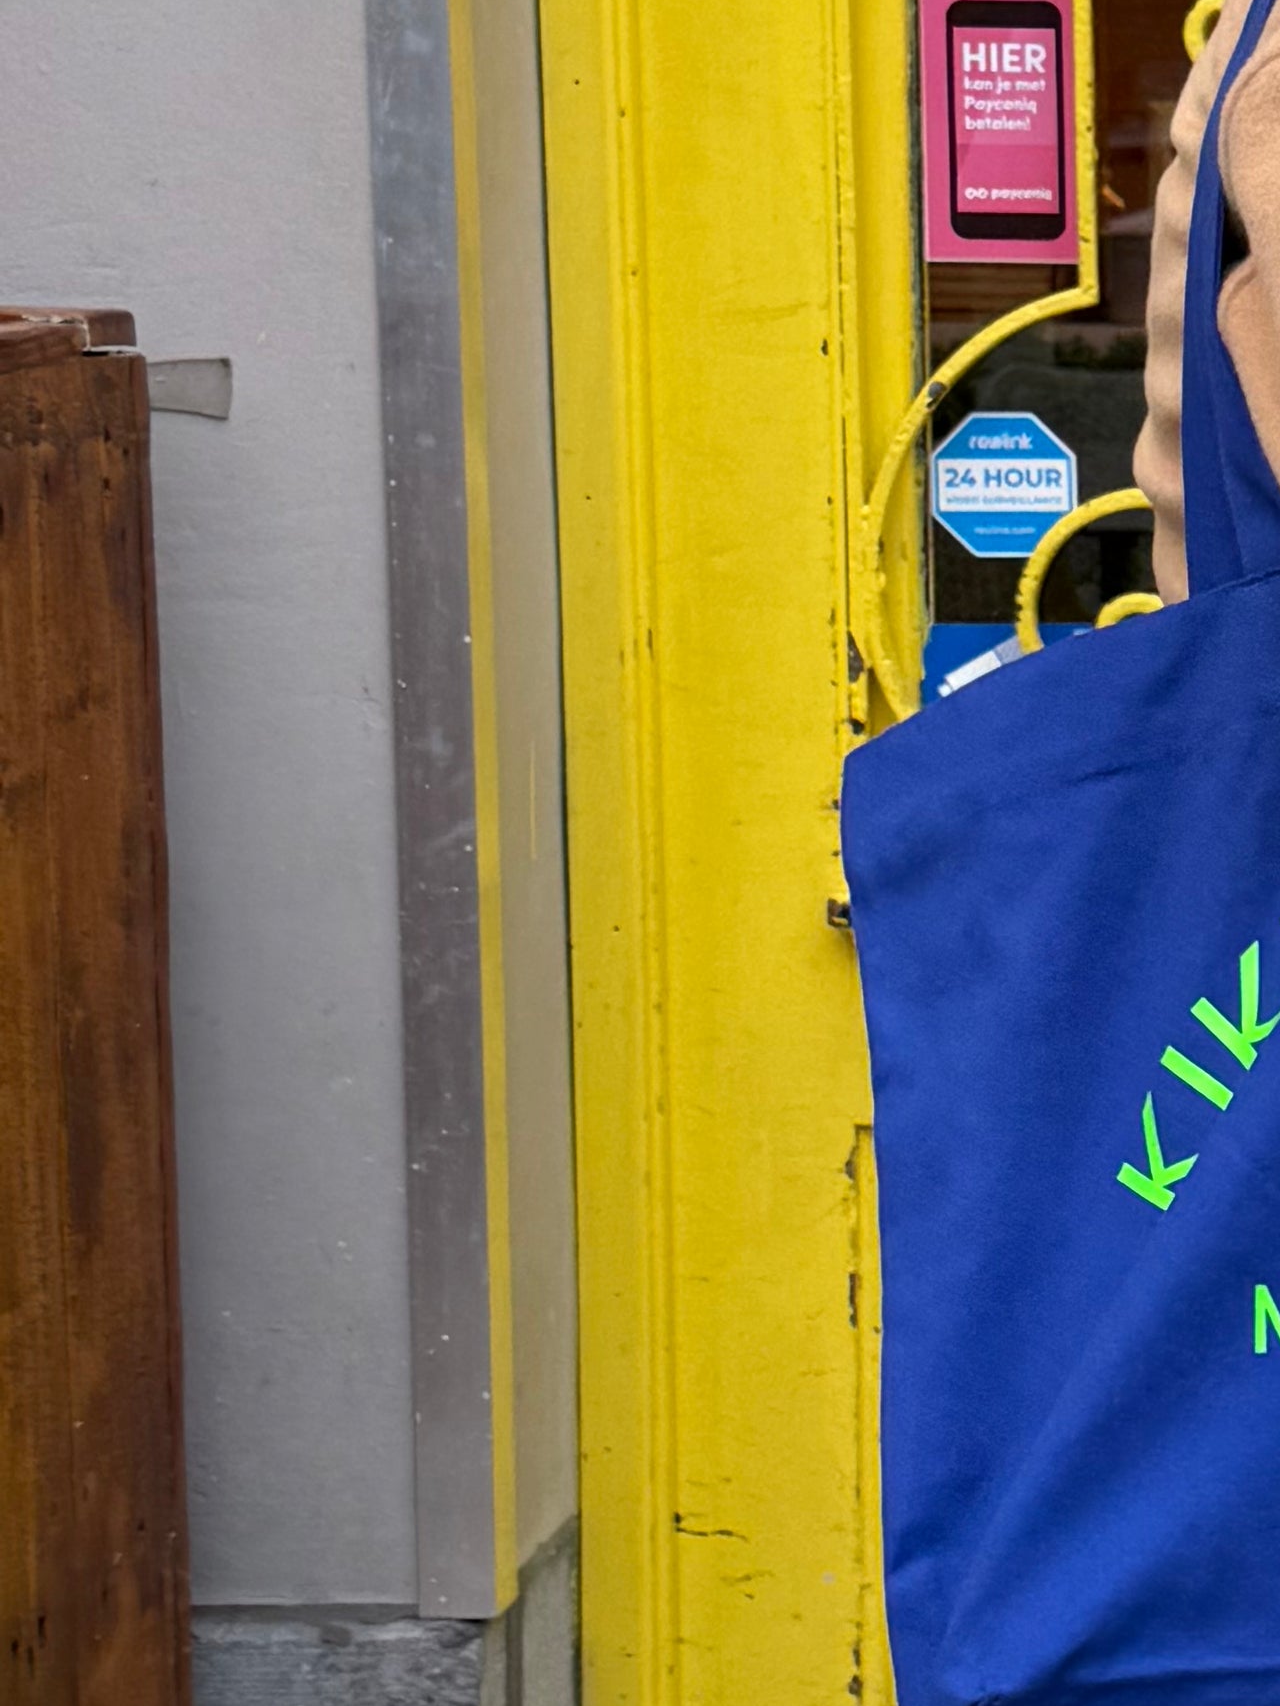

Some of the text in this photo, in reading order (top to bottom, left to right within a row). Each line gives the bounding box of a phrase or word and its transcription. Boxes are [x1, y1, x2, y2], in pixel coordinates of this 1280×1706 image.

[962, 42, 1047, 73] HIER
[963, 76, 1046, 95] kan je met
[963, 95, 1037, 114] Payconiq
[964, 115, 1031, 131] betalen!
[968, 432, 1034, 450] reolink
[944, 467, 1063, 488] 24 HOUR
